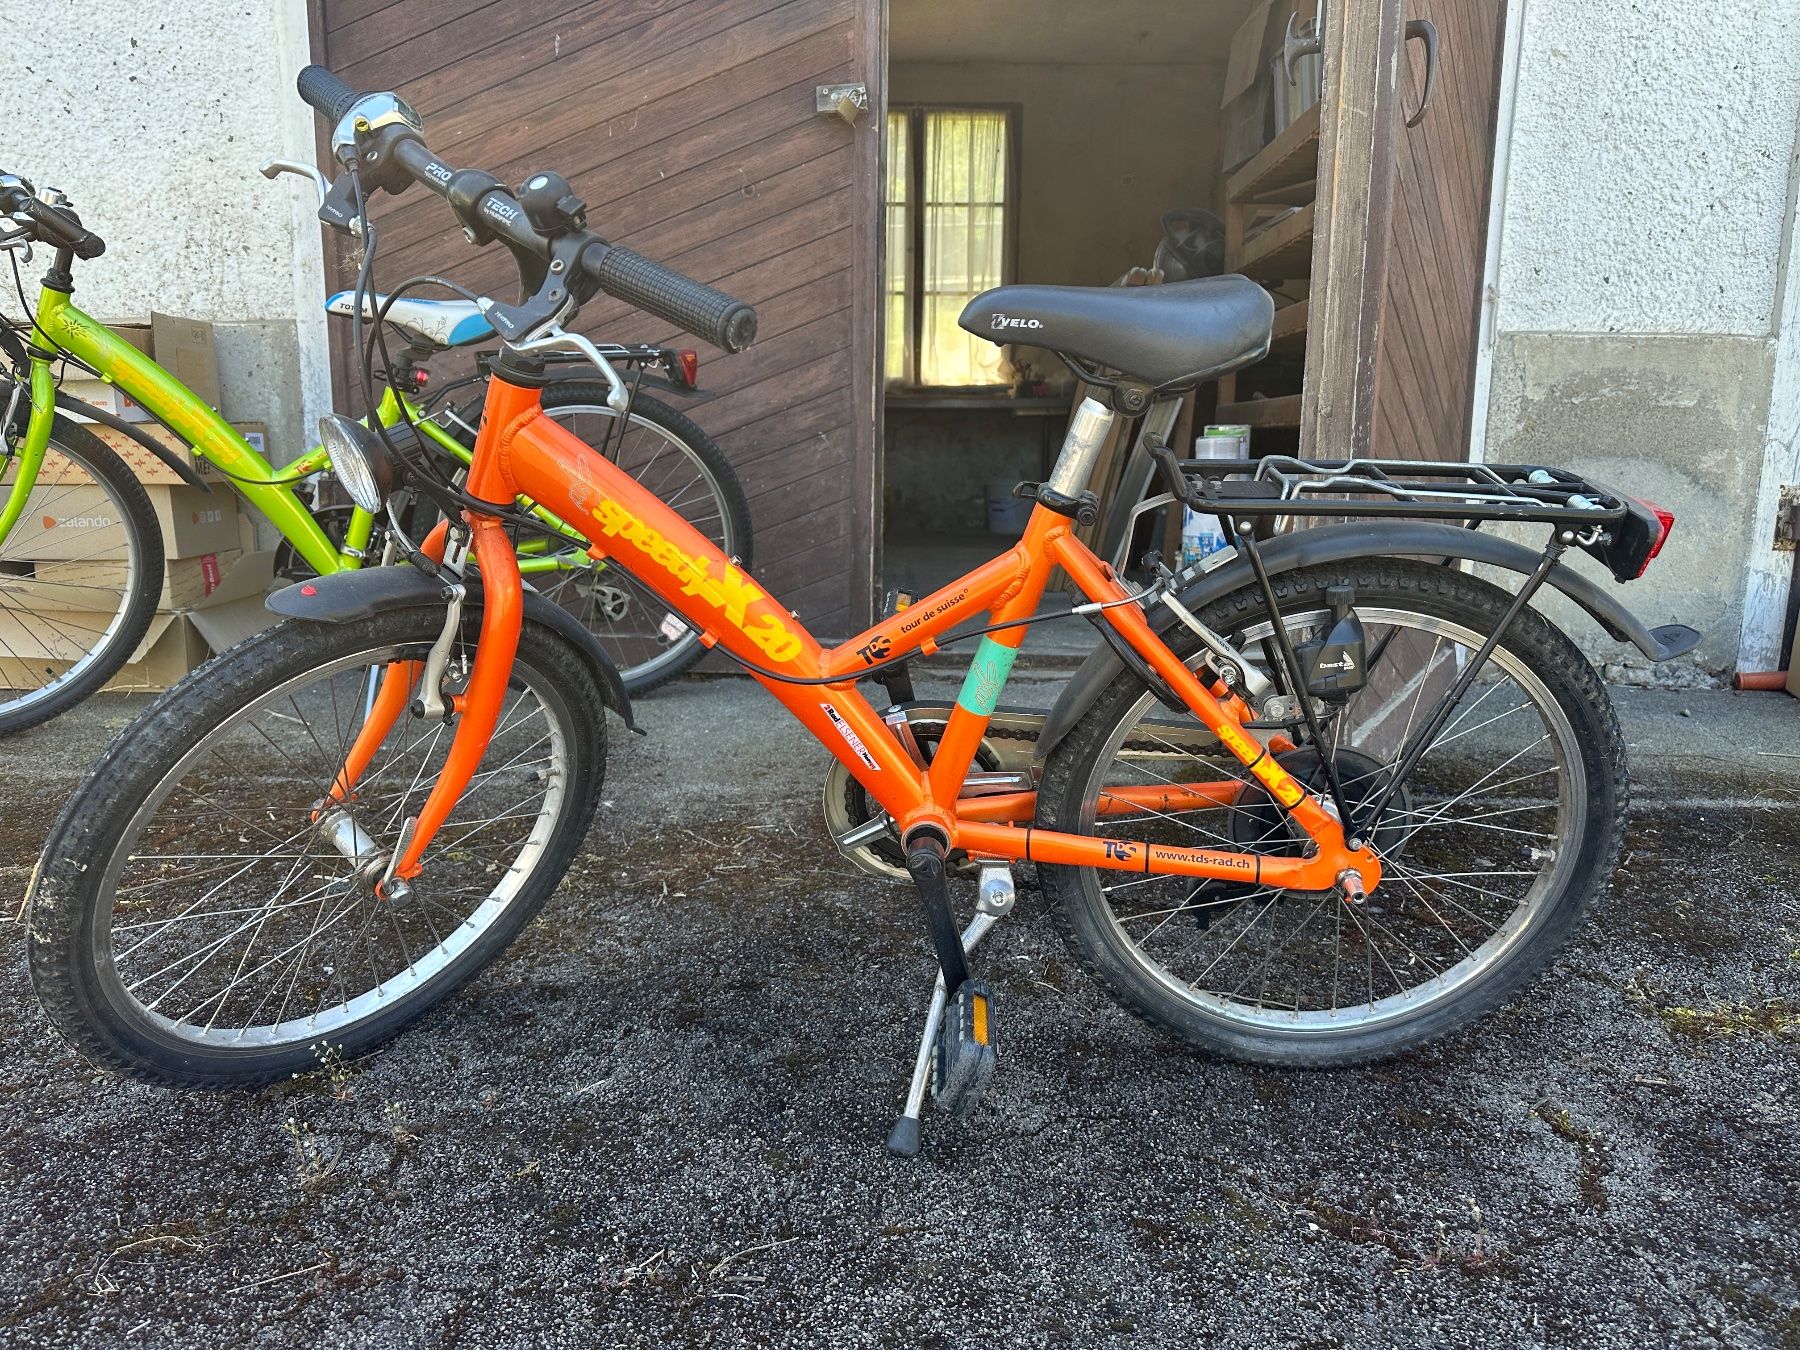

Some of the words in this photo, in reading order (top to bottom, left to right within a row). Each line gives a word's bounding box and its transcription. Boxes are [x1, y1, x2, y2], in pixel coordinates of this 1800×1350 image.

[425, 163, 452, 180] PRO
[486, 197, 518, 220] TECH
[340, 303, 368, 313] TOTM
[1002, 317, 1041, 328] VELO
[58, 515, 111, 528] zalando
[900, 618, 921, 633] tour
[923, 610, 935, 621] de
[743, 614, 802, 662] 20
[1155, 850, 1250, 869] www.tds-rad.ch
